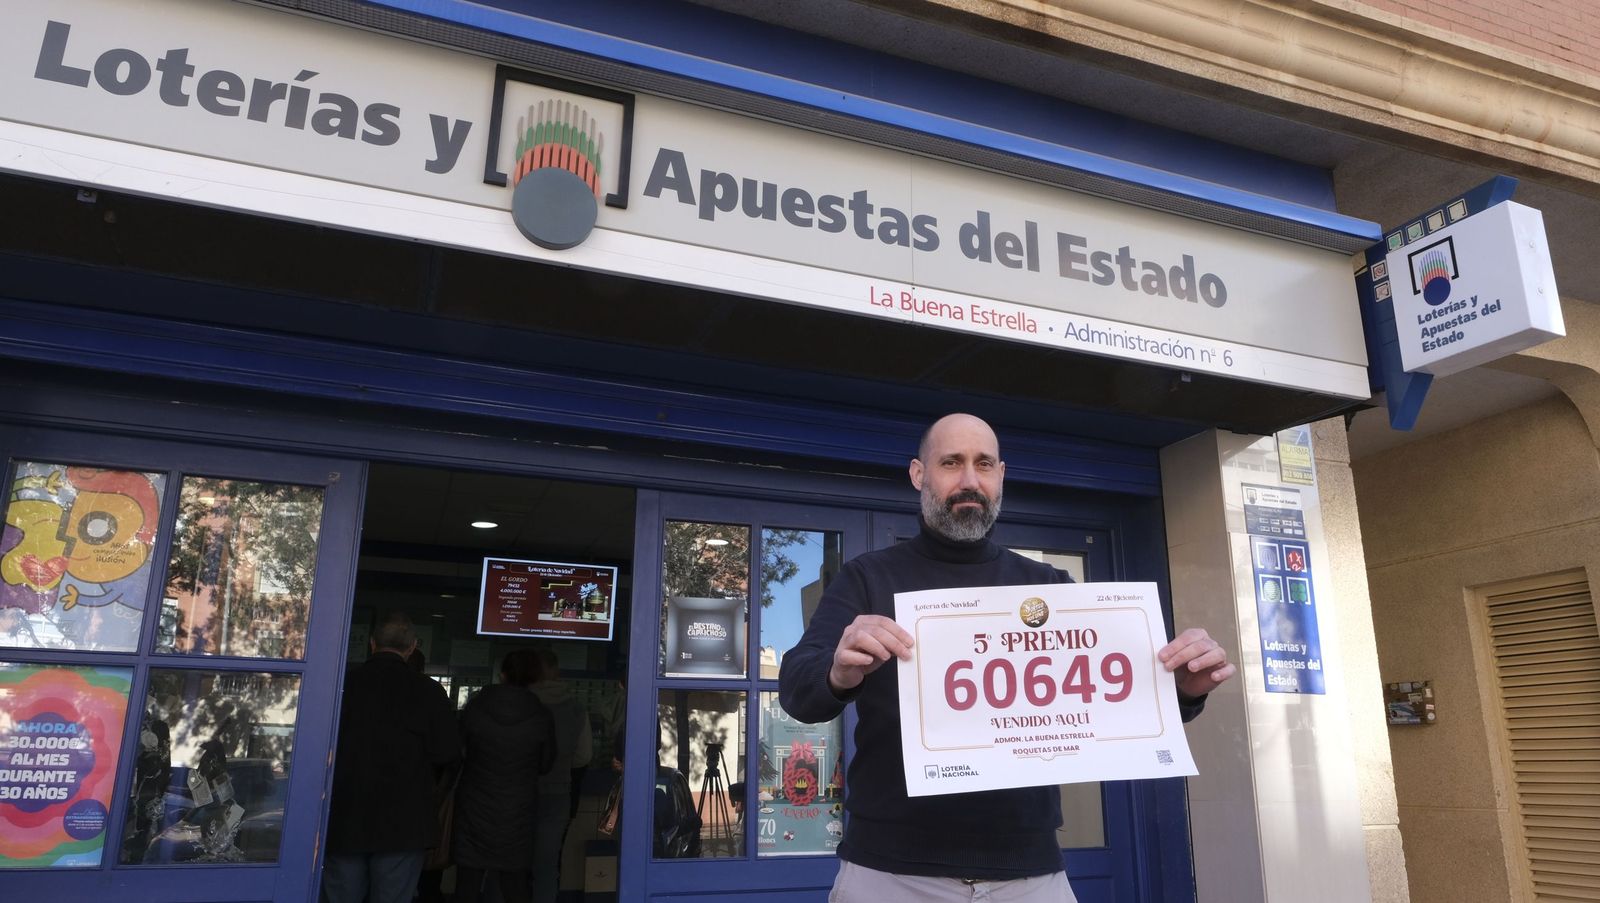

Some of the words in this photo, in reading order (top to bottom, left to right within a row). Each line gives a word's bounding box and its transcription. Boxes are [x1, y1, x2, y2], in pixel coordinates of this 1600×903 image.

[34, 20, 401, 147] Loterías
[424, 114, 473, 174] y
[643, 147, 940, 252] Apuestas
[959, 210, 1040, 272] del
[1056, 232, 1228, 308] Estado
[1417, 299, 1467, 325] Loterías
[1470, 295, 1478, 308] y
[869, 285, 894, 309] La
[900, 291, 964, 322] Buena
[970, 303, 1037, 334] Estrella
[1064, 320, 1195, 361] Administración
[1222, 348, 1234, 367] 6
[1421, 310, 1478, 339] Apuestas
[1481, 299, 1502, 317] del
[1421, 330, 1465, 353] Estado
[687, 629, 727, 638] CAPRICHOSO
[693, 622, 721, 631] DESTINO
[1001, 628, 1098, 653] PREMIO
[1264, 640, 1299, 652] Loterías
[1301, 644, 1307, 655] y
[1266, 657, 1305, 670] Apuestas
[1307, 658, 1321, 670] del
[944, 652, 1133, 711] 60649
[1267, 674, 1297, 686] Estado
[990, 715, 1052, 730] VENDIDO
[1055, 710, 1090, 727] AQUÍ
[15, 722, 77, 734] AHORA
[994, 736, 1023, 744] ADMON.
[1035, 734, 1059, 742] BUENA
[1060, 731, 1095, 740] ESTRELLA
[1012, 746, 1051, 755] ROQUETAS
[10, 753, 33, 765] AL
[36, 753, 70, 766] MES
[941, 764, 971, 772] LOTERÍA
[0, 770, 76, 783] DURANTE
[0, 786, 22, 799] 30
[23, 784, 68, 800] AÑOS
[758, 819, 776, 836] 70
